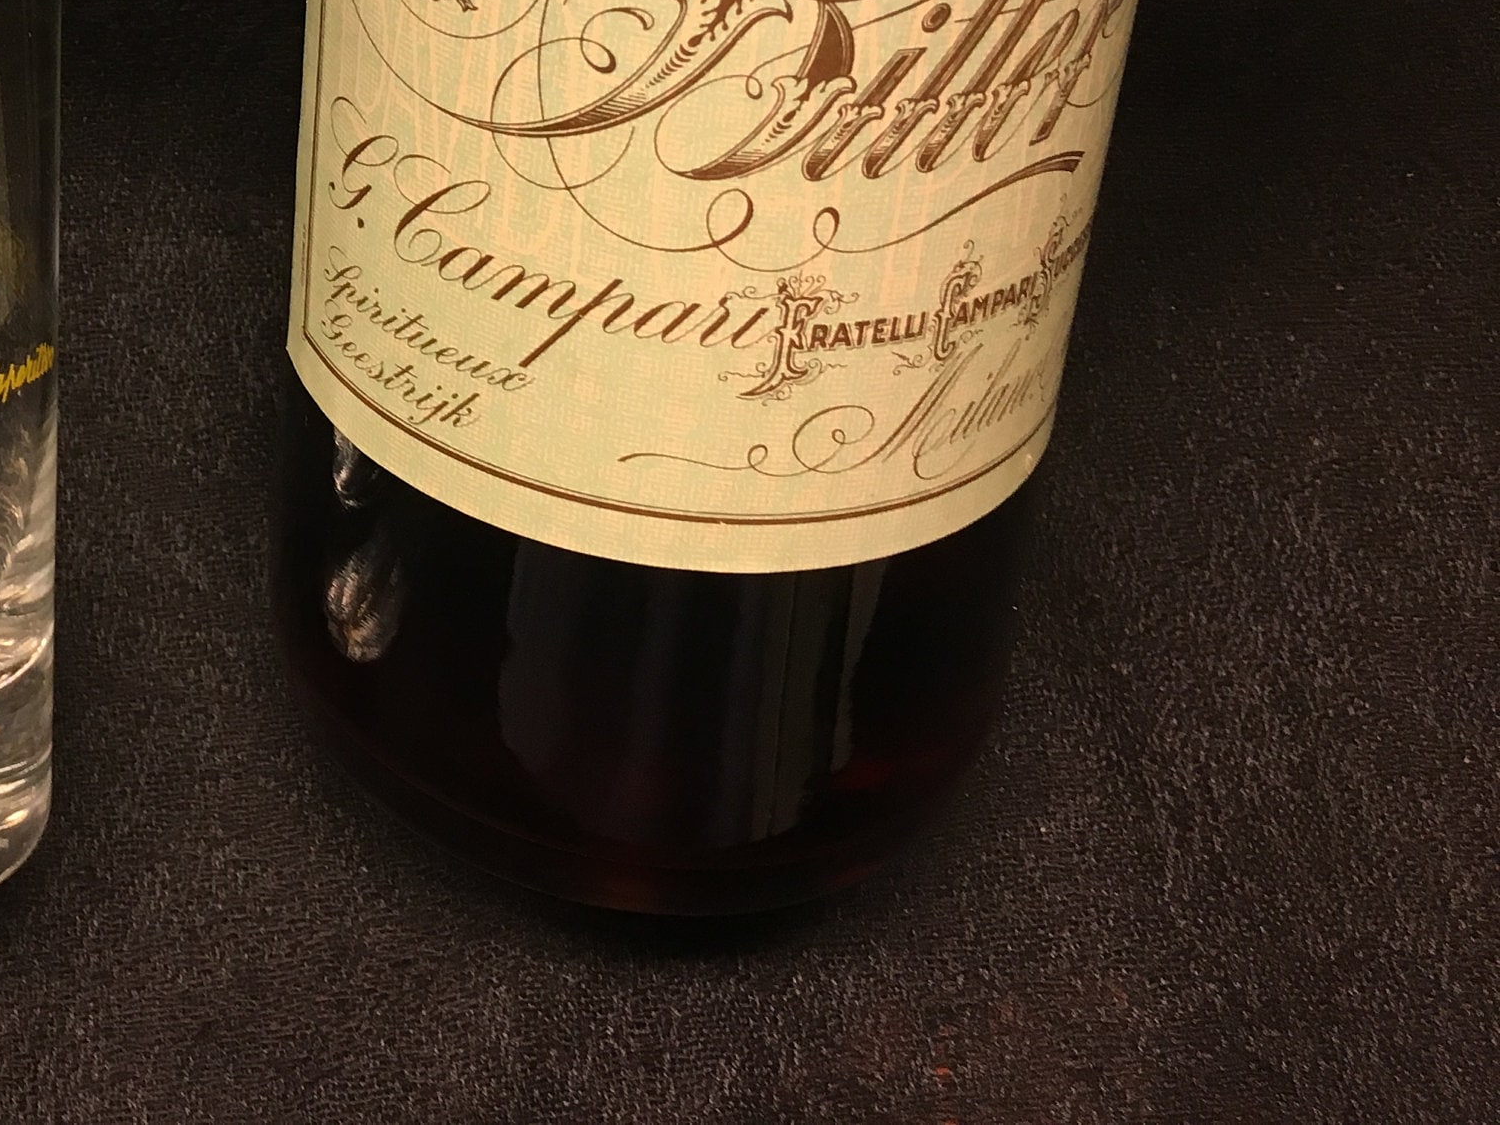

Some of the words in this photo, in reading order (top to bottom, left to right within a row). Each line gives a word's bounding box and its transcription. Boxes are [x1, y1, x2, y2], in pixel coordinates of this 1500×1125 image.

[324, 246, 535, 392] Spiritueux
[393, 154, 770, 368] Campari
[321, 299, 481, 429] Geestrijk
[738, 283, 926, 399] FRATELLI
